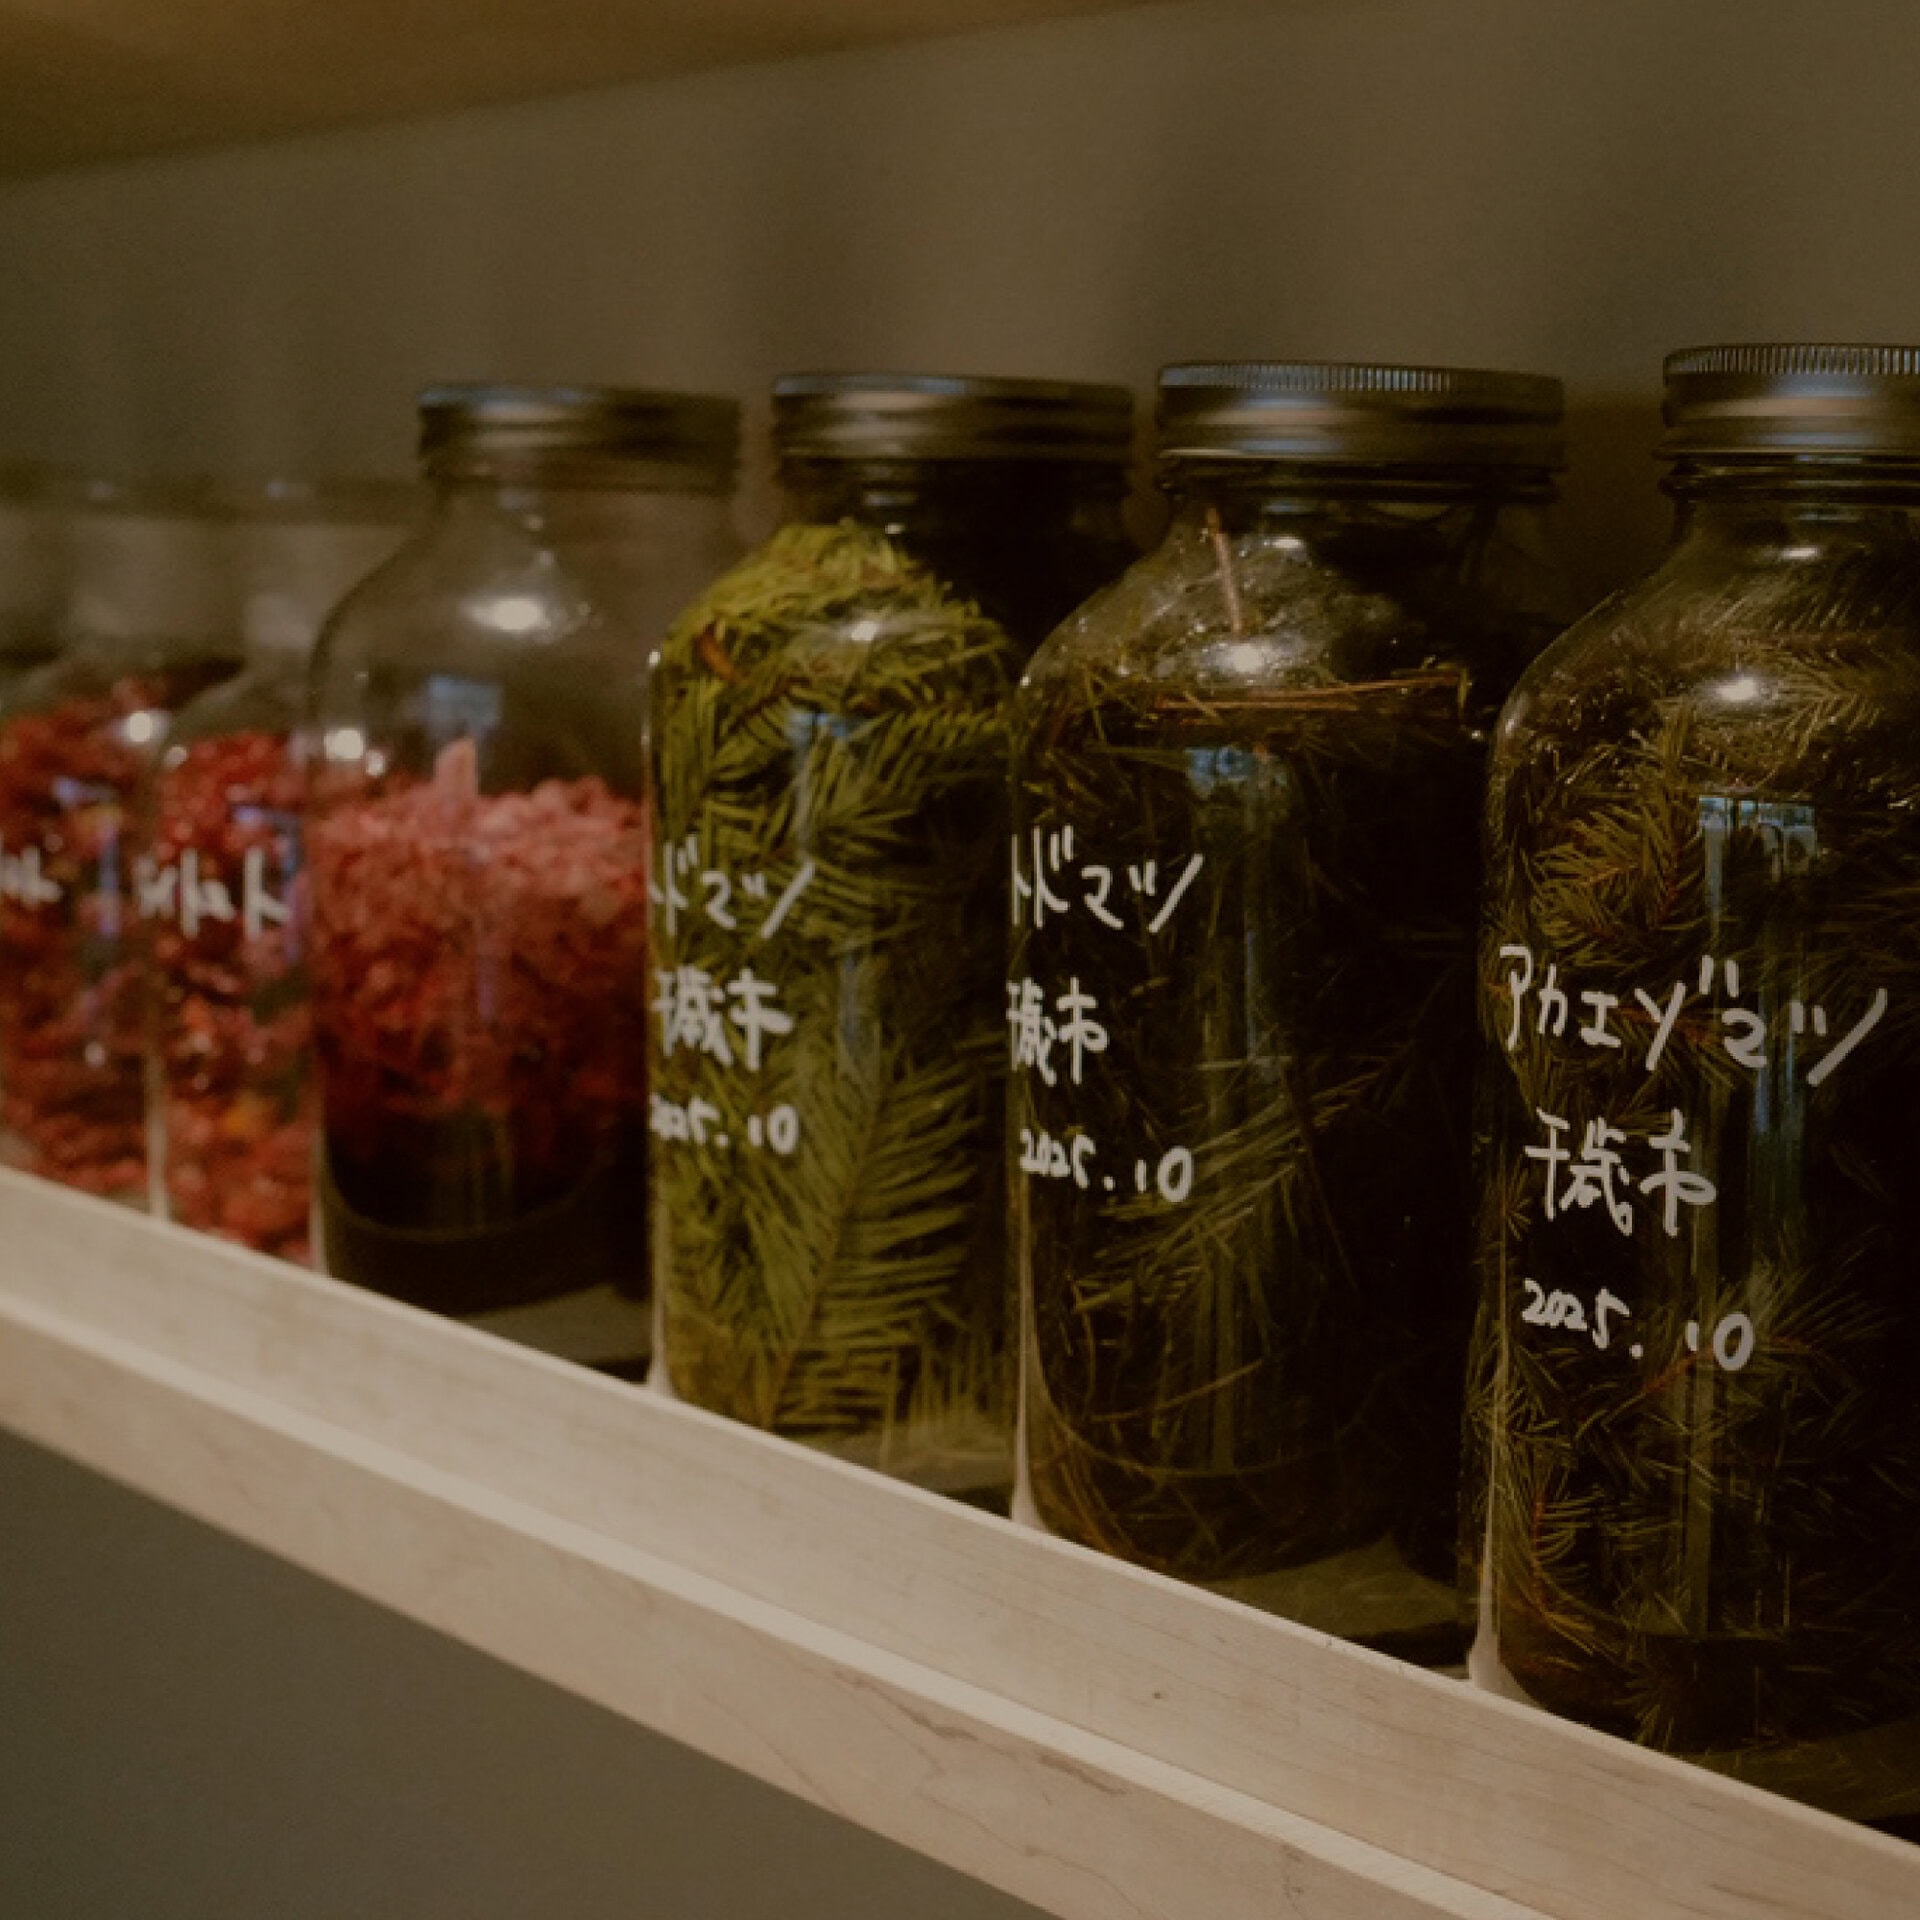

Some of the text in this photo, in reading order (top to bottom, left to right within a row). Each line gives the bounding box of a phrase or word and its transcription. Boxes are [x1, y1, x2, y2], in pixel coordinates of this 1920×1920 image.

[1010, 823, 1205, 935] トドマツ
[1499, 943, 1889, 1087] アカエゾマツ
[1018, 1127, 1194, 1204] 2025.10
[1524, 1106, 1718, 1238] 千歳市
[1520, 1277, 1755, 1371] 2025.10
